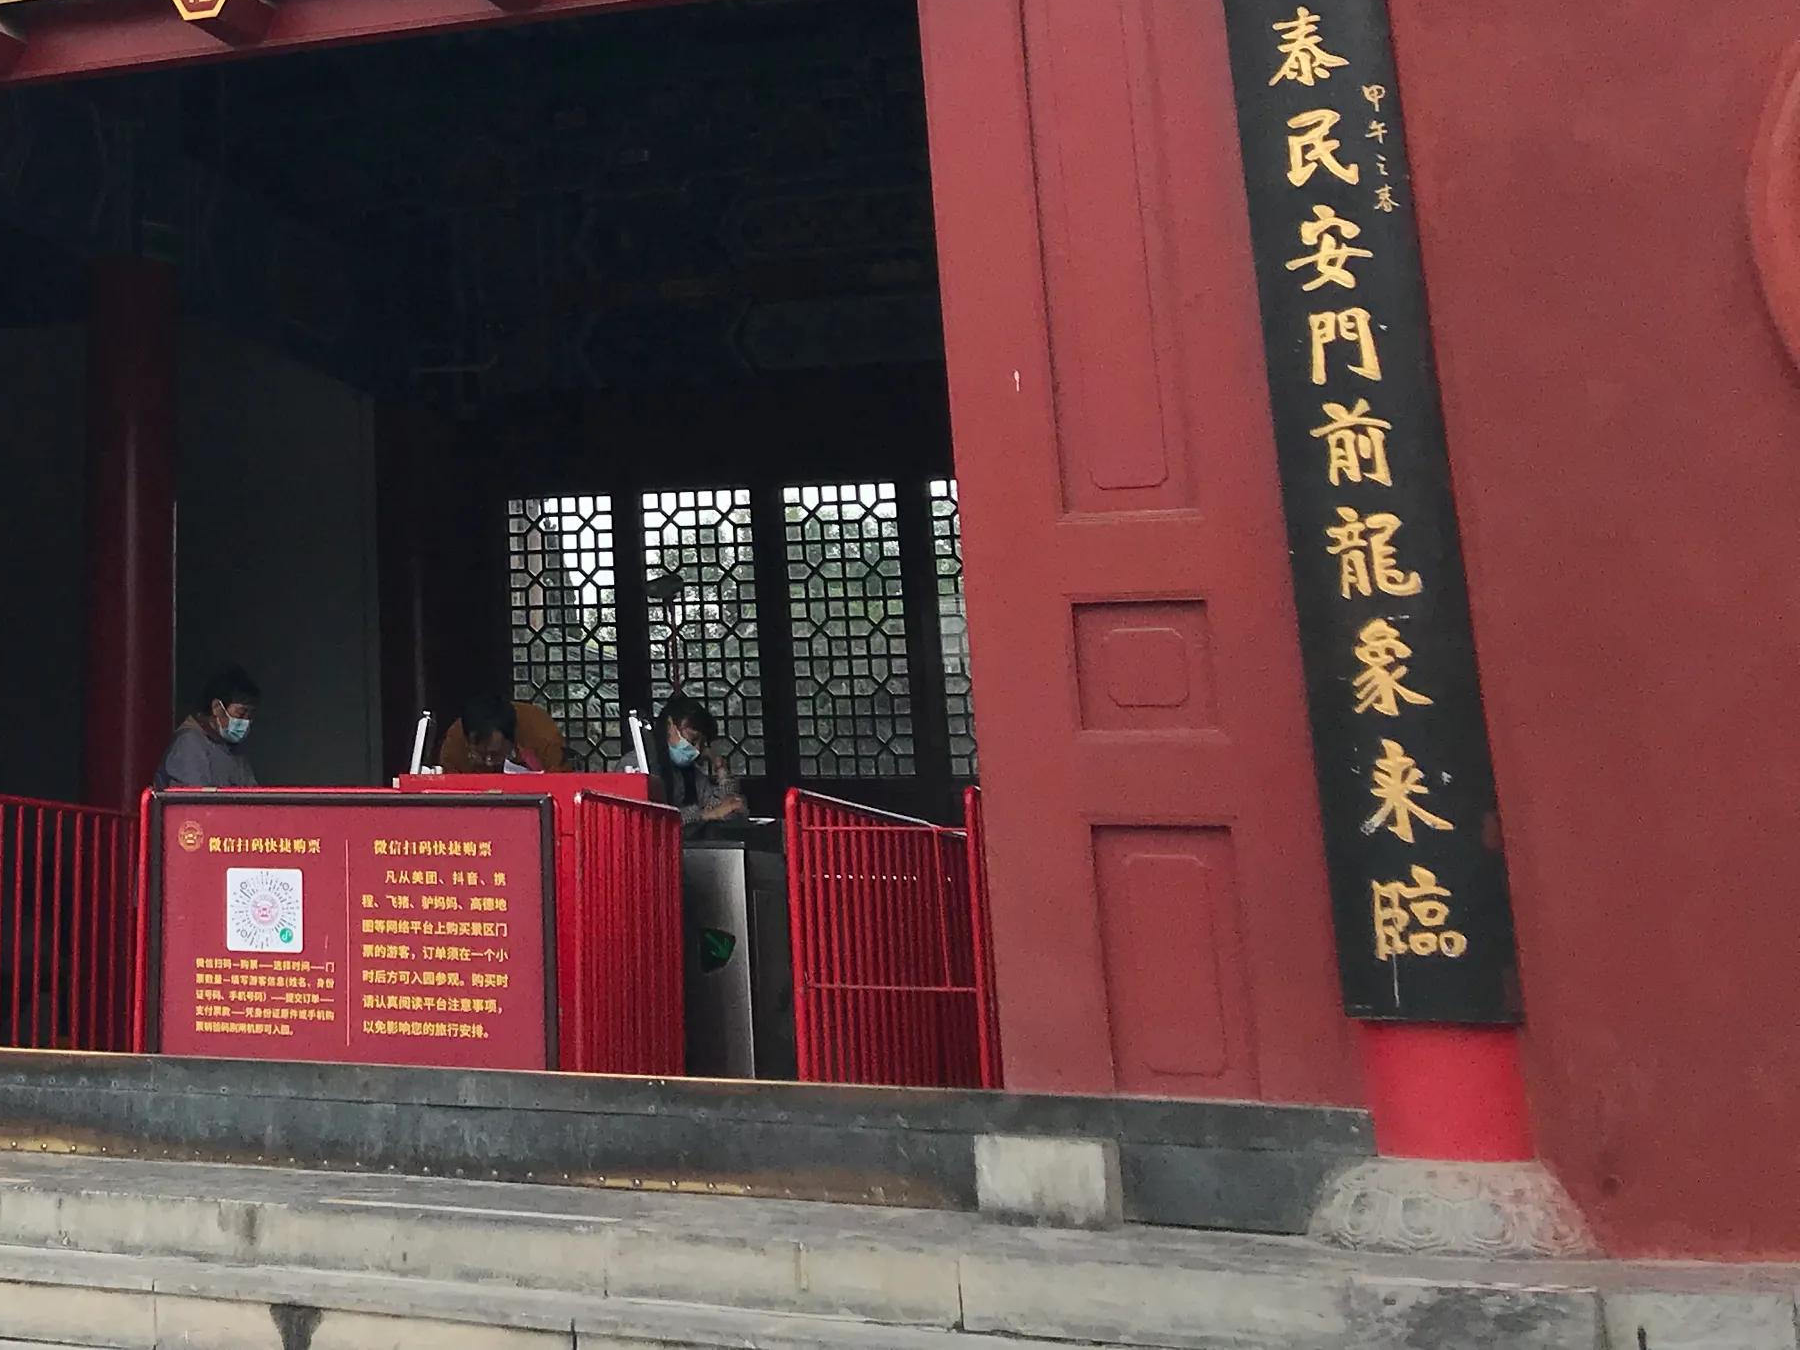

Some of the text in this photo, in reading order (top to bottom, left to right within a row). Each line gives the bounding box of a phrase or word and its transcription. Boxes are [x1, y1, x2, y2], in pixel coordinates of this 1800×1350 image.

[208, 836, 321, 855] 微信扫码快捷购票
[373, 839, 493, 857] 微信扫码快捷购票
[361, 919, 508, 938] 图等网络平台上购买景区门
